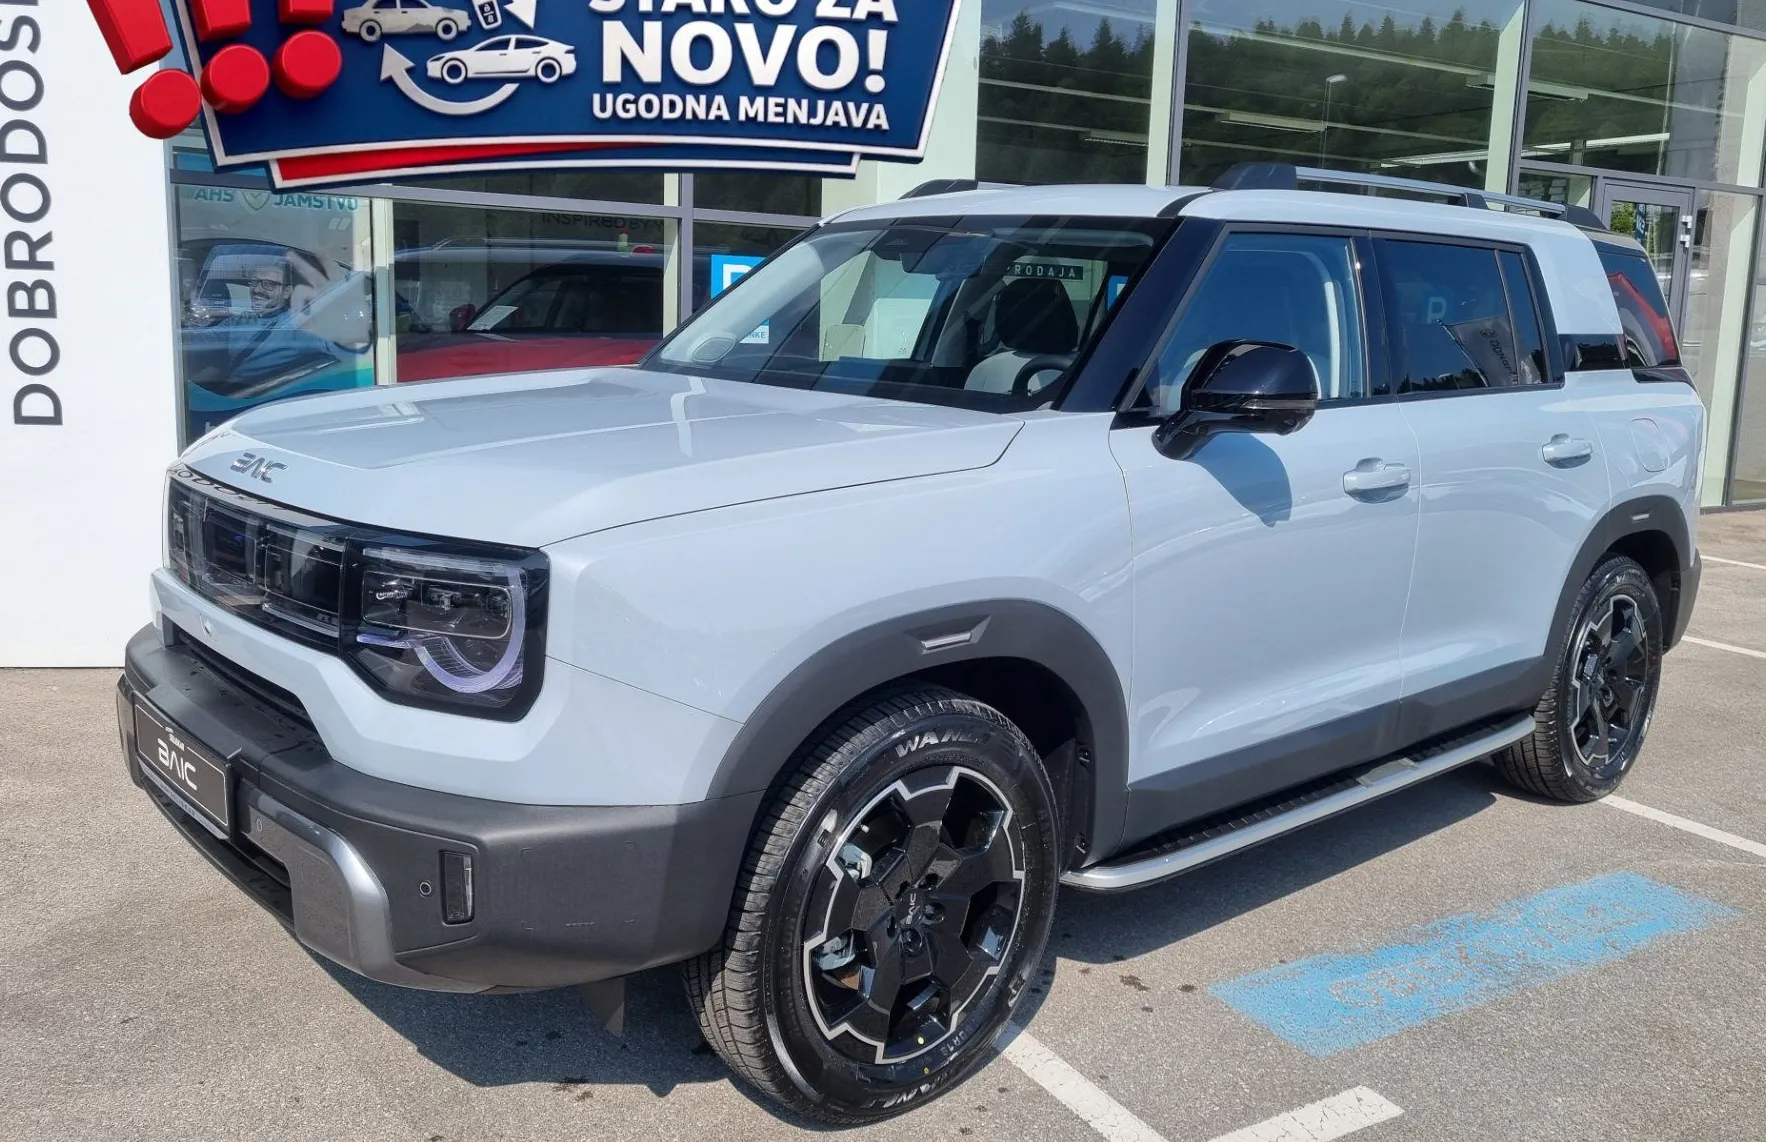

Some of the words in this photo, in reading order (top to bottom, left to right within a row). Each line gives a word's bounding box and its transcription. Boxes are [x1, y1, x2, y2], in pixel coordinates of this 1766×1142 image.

[0, 0, 63, 426] DOBRODOS
[1006, 264, 1077, 279] RODAJA
[230, 452, 290, 484] BAIC
[157, 737, 198, 791] BAIC
